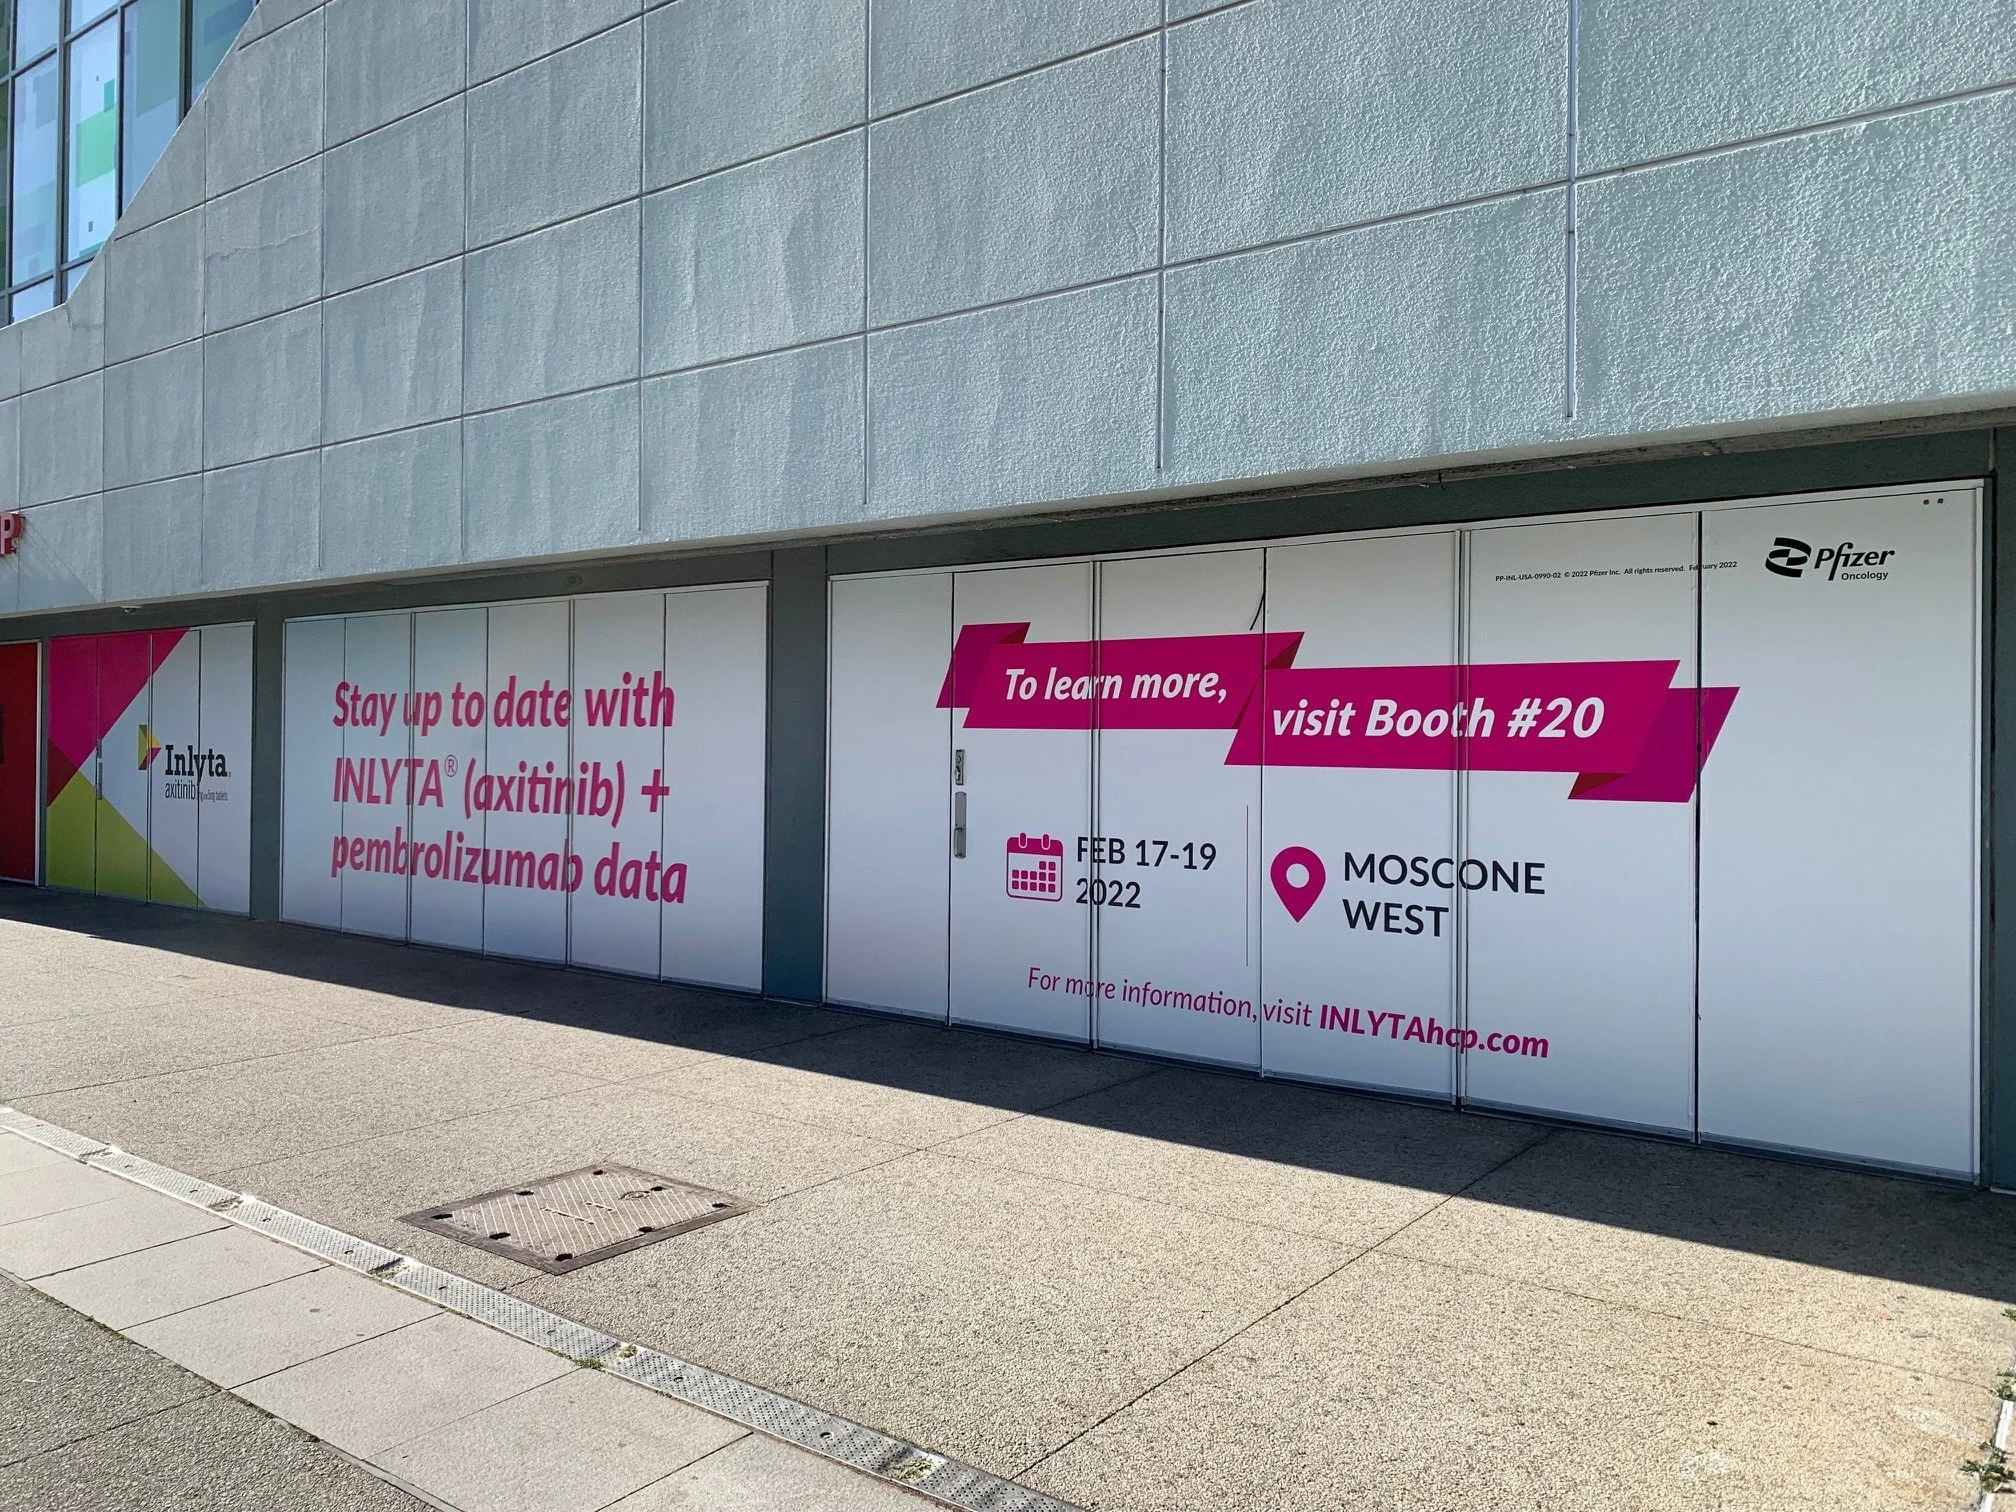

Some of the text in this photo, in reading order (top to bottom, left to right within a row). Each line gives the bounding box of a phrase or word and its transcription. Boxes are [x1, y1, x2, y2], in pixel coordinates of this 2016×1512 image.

[1495, 571, 1562, 582] PP-INL-USA-0990-02
[1571, 570, 1589, 578] 2022
[1588, 568, 1608, 578] Pfizer
[1609, 568, 1621, 576] Inc.
[1623, 567, 1634, 575] All
[1634, 566, 1653, 576] rights
[1654, 564, 1685, 573] reserved.
[1689, 563, 1718, 571] Febuary
[1719, 561, 1738, 569] 2022
[1814, 542, 1895, 581] Pfizer
[1841, 570, 1889, 581] Oncology
[333, 670, 675, 736] Stay up to date with
[1005, 666, 1227, 704] To learn more,
[1272, 697, 1605, 738] visit Booth #20
[165, 745, 228, 783] Inlyta
[165, 779, 196, 800] axitinib
[464, 757, 625, 829] (axitinib)
[641, 768, 670, 813] +
[331, 826, 688, 904] pembrolizumab data
[1077, 836, 1217, 871] FEB 17-19
[1075, 877, 1141, 909] 2022
[1344, 852, 1546, 895] MOSCONE
[1342, 898, 1449, 937] WEST
[1028, 966, 1549, 1059] For more information, visit INLYTAhcp.com
